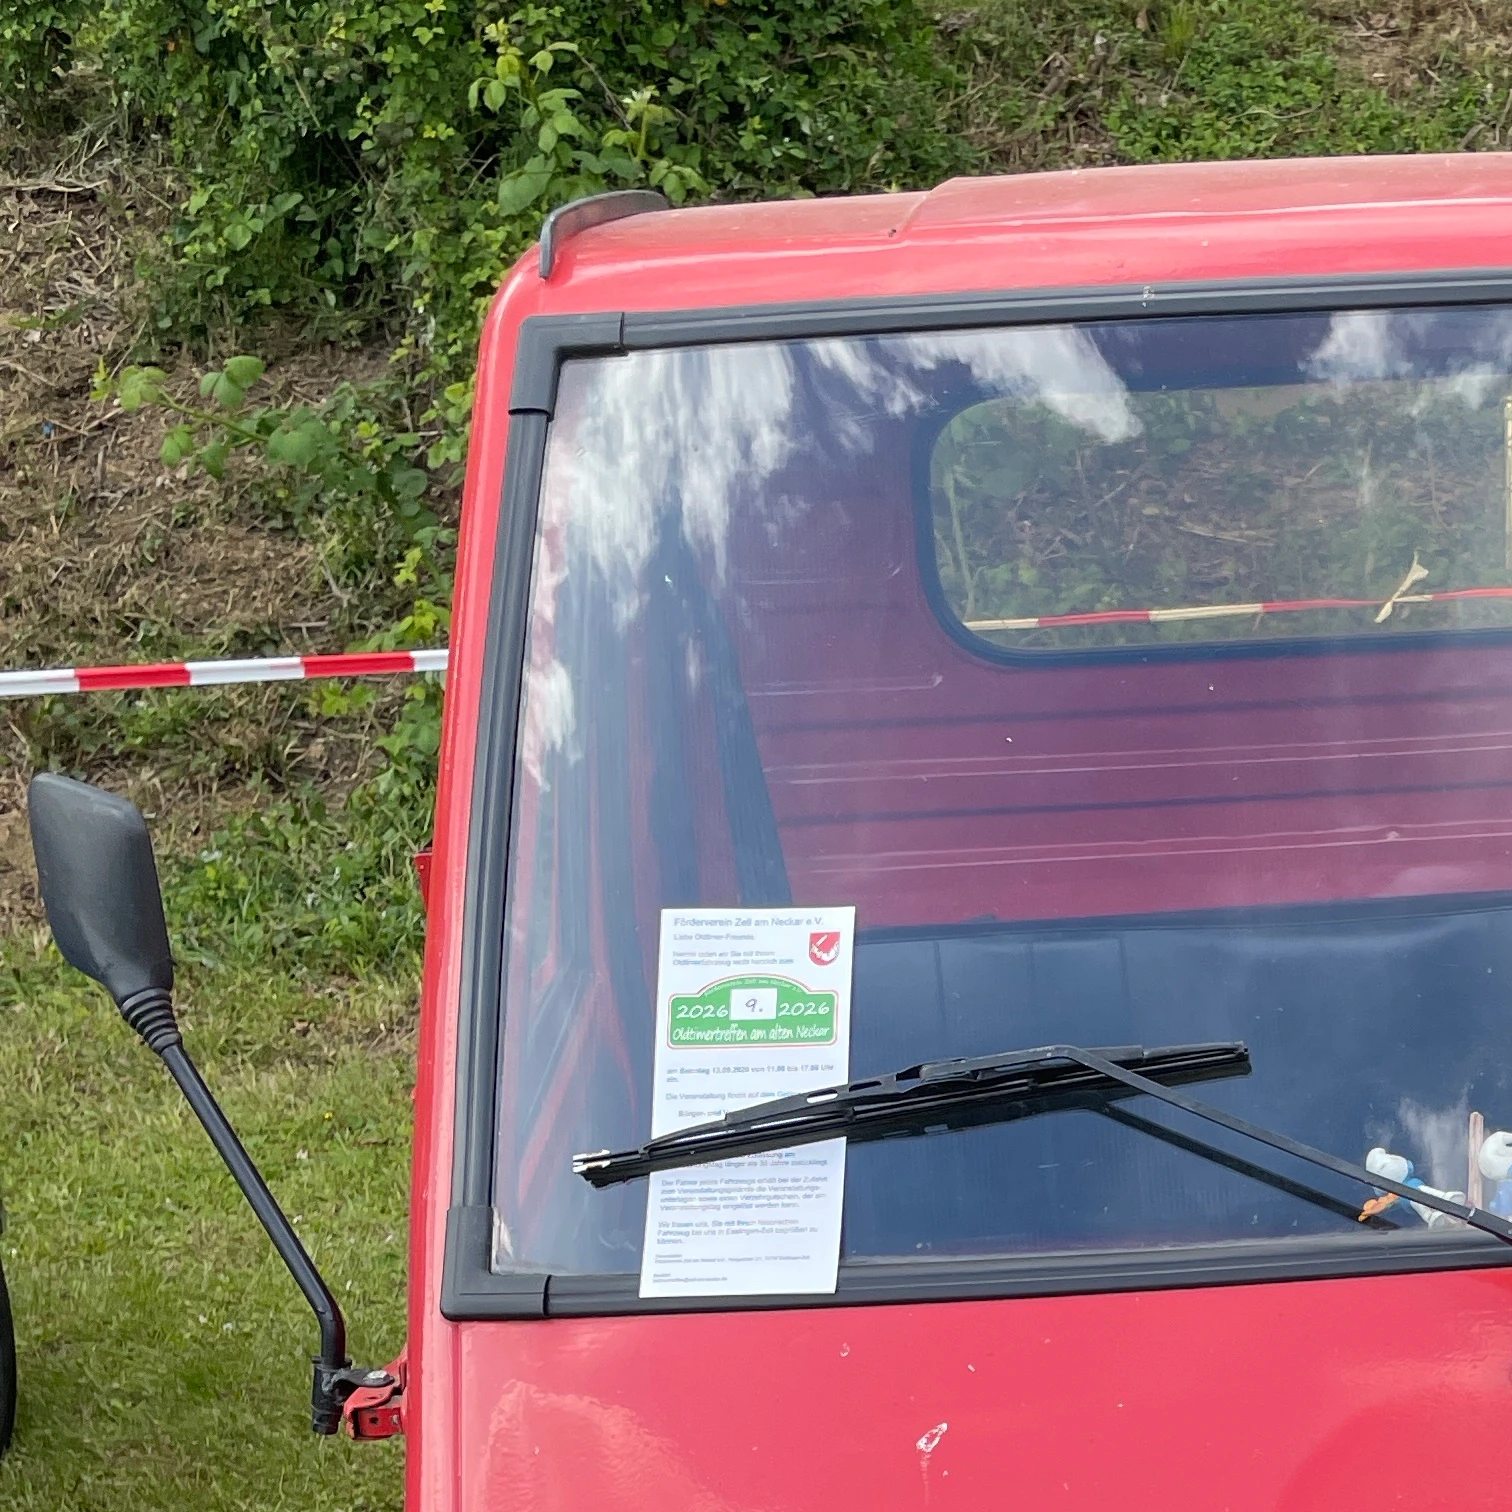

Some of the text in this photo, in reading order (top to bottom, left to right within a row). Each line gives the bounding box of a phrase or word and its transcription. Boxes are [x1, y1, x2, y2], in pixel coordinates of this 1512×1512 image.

[676, 1004, 729, 1020] 2026
[777, 1002, 830, 1018] 2026
[672, 1022, 831, 1042] Oldtimertreffen am alten Neckar
